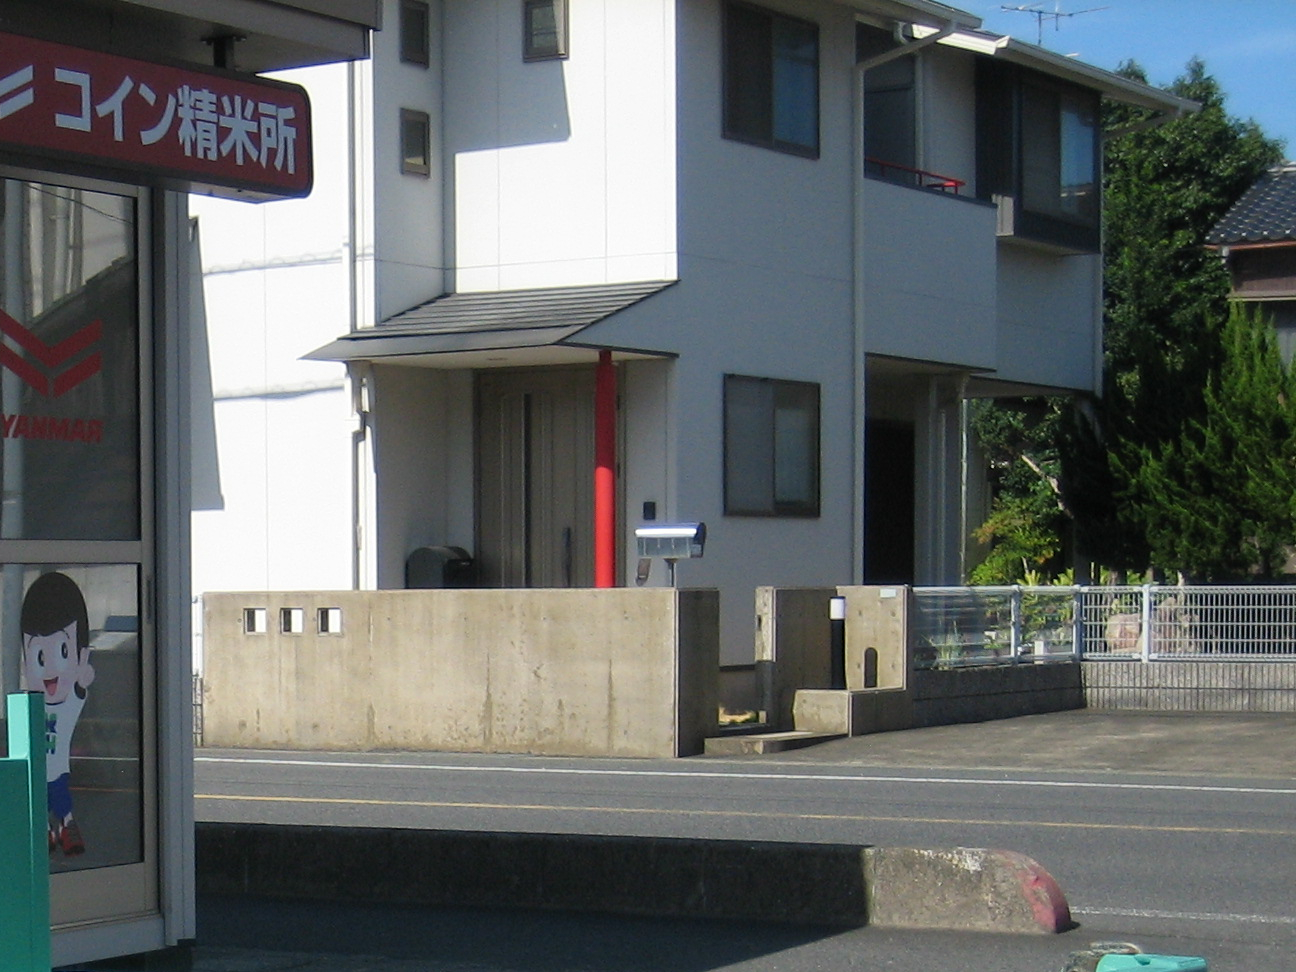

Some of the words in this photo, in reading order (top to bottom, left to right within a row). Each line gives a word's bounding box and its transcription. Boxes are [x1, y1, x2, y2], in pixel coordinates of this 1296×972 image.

[55, 67, 296, 174] コイン精米所
[0, 414, 105, 443] YANMAR
